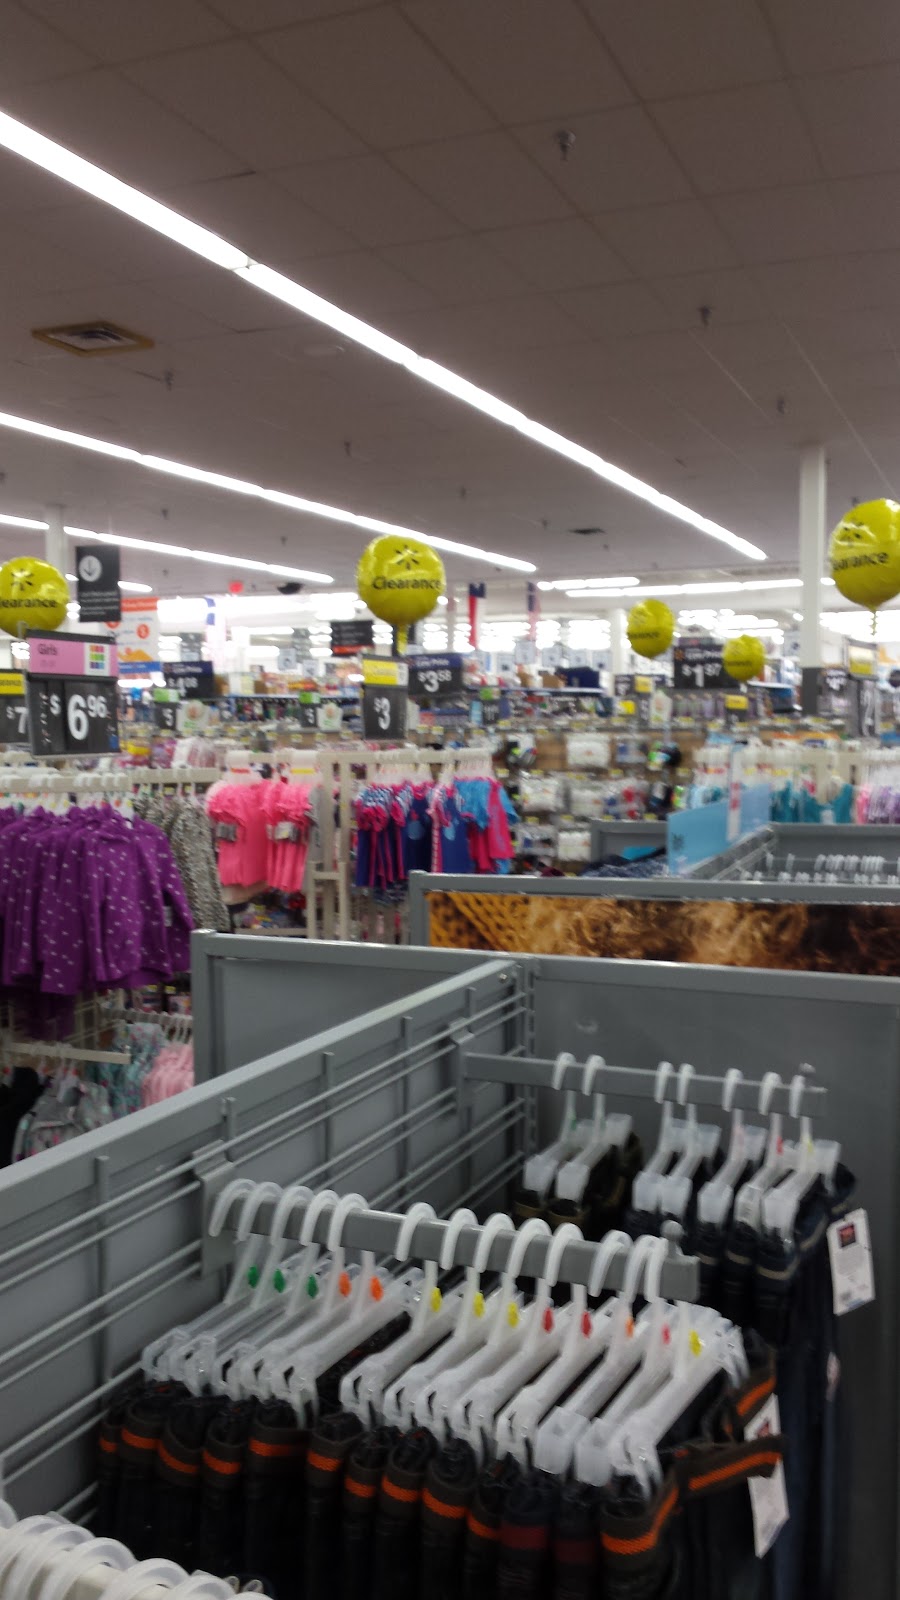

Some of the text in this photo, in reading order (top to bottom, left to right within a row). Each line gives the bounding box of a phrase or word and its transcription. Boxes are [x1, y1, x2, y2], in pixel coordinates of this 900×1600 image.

[372, 576, 441, 590] Clearance
[0, 598, 57, 609] earance
[37, 643, 58, 656] Girls
